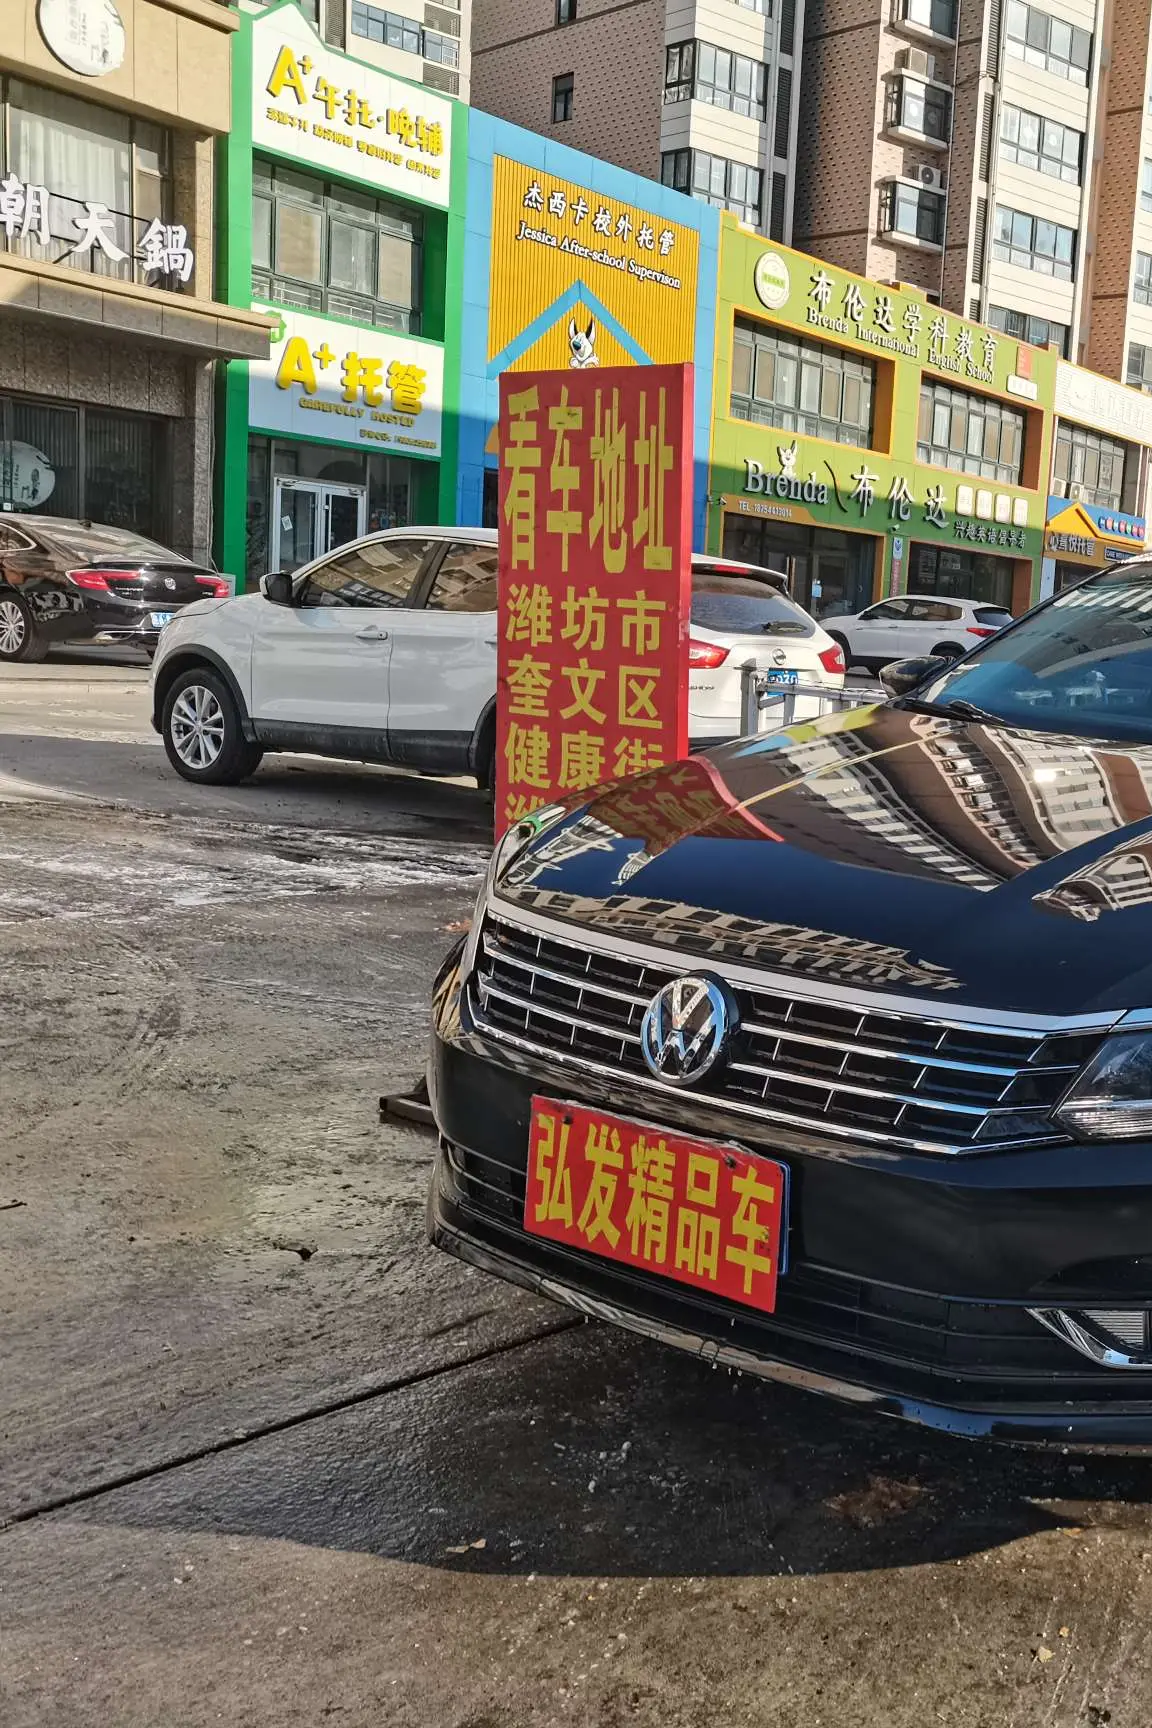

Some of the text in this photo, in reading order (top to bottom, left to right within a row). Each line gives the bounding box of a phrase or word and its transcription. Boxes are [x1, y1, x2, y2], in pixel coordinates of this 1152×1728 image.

[516, 220, 558, 248] Jessica
[560, 235, 627, 271] After-school
[523, 180, 676, 256] 杰西卡校外托管
[807, 305, 849, 334] Brenda
[855, 322, 920, 358] International
[927, 348, 963, 374] English
[808, 269, 999, 371] 布伦达学科教育
[503, 384, 674, 575] 看车地址
[744, 458, 829, 506] Brenda
[850, 465, 949, 529] 布伦达
[505, 583, 666, 656] 潍坊市
[506, 653, 664, 729] 奎文区
[535, 1112, 776, 1296] 弘发精品车
